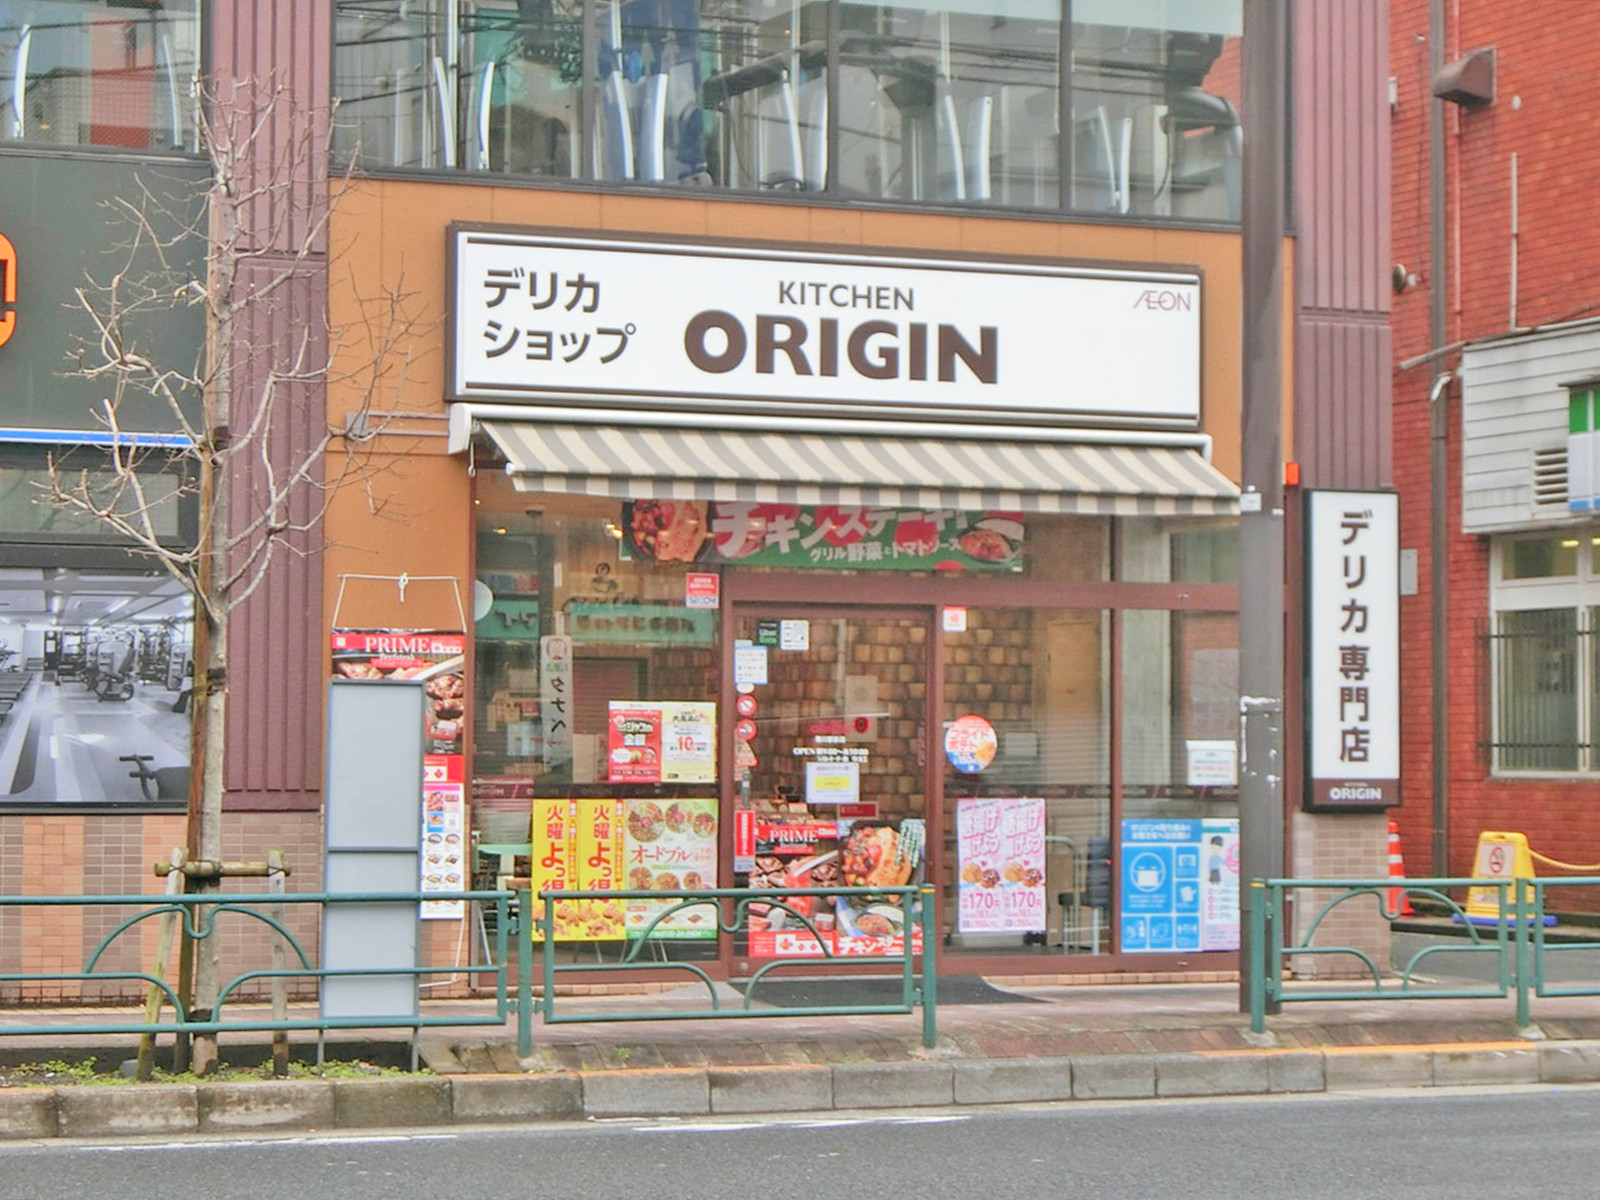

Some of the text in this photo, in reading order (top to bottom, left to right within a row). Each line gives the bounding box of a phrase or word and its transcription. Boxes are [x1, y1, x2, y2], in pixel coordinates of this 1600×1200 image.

[483, 266, 600, 313] デリカ
[778, 280, 914, 311] KITCHEN
[483, 319, 637, 364] ショップ
[684, 308, 998, 384] ORIGIN
[364, 636, 430, 653] PRIME
[1339, 509, 1373, 763] デリカ専門店
[1329, 787, 1382, 800] ORIGIN
[769, 829, 819, 843] PRIME
[629, 844, 693, 865] オードブル
